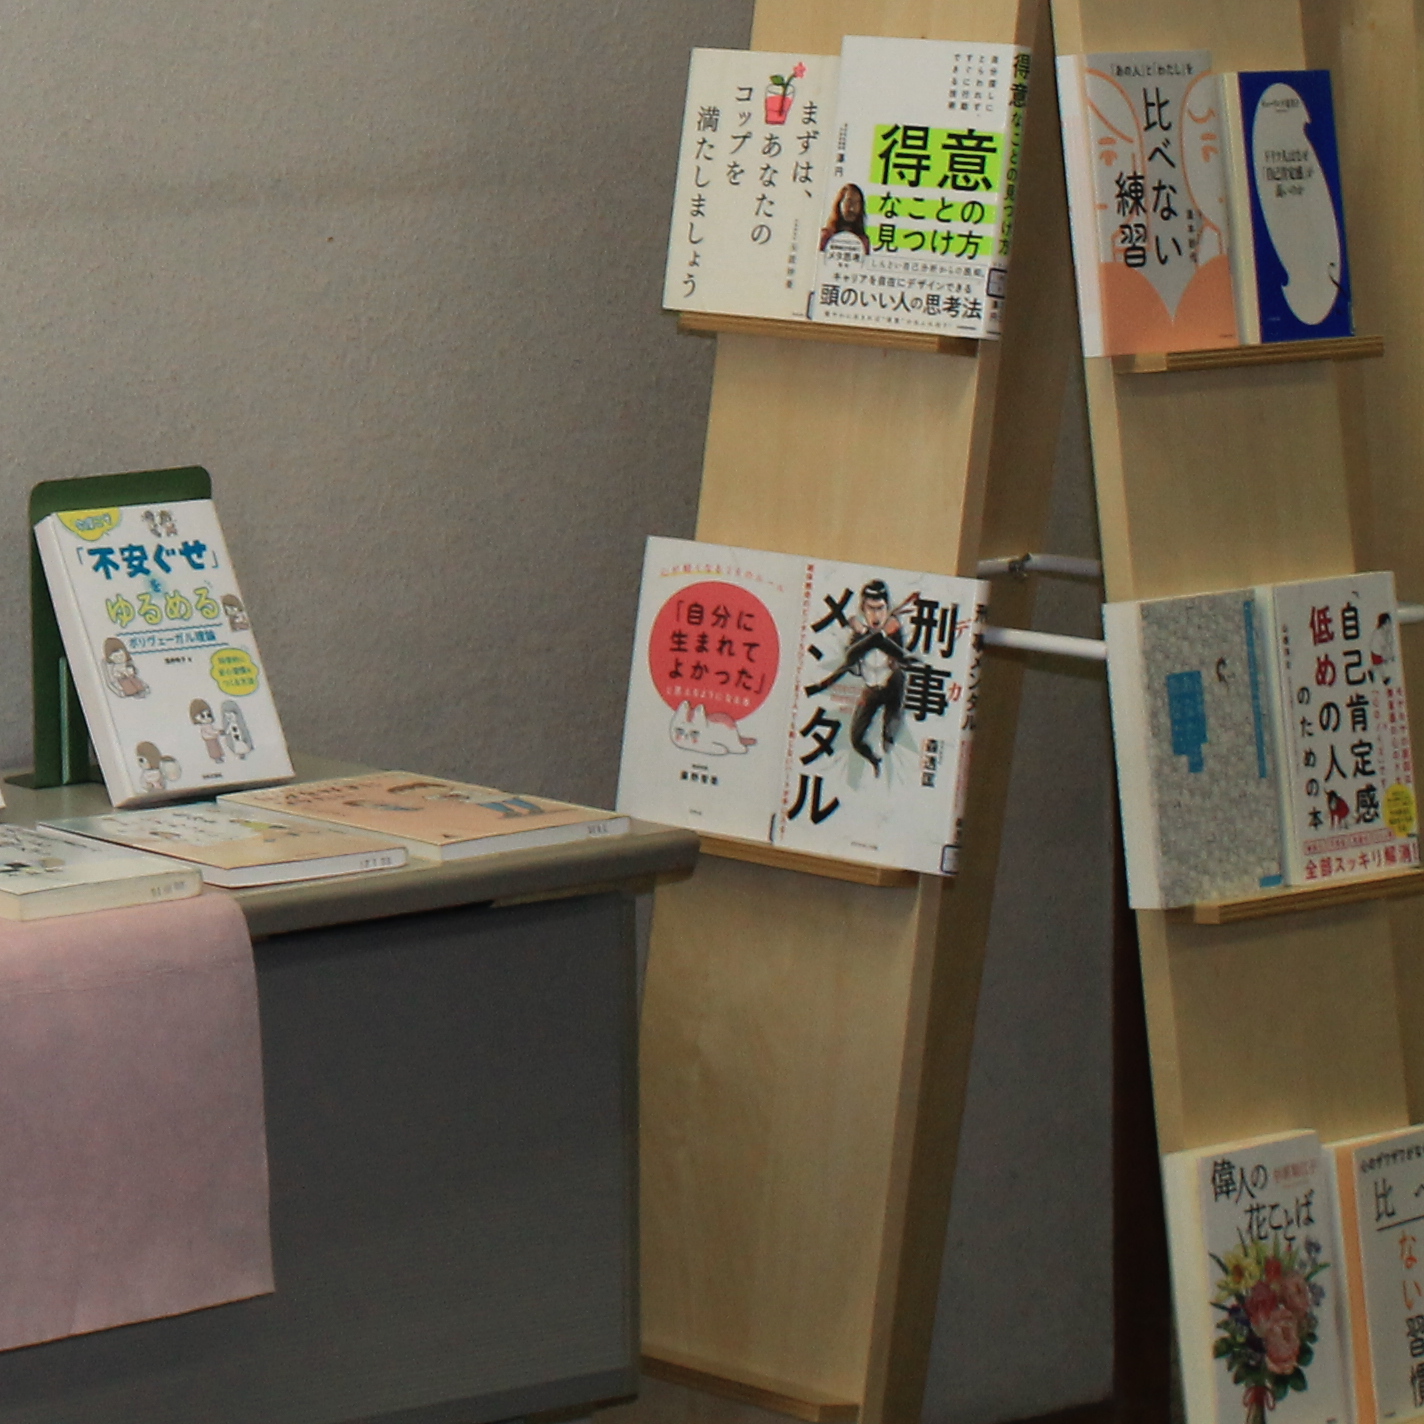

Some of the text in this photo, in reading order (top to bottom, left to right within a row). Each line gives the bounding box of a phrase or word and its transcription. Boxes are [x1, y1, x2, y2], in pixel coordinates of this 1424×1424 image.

[726, 85, 753, 186] コップを
[791, 100, 820, 199] まずは、
[877, 124, 997, 192] 得意
[1141, 86, 1183, 265] 比べない
[682, 105, 720, 298] 満たしましょう
[751, 132, 782, 245] あなたの
[879, 191, 985, 226] なことの
[1114, 170, 1148, 268] 練習
[872, 224, 983, 260] 見つけ方
[819, 282, 983, 320] 頭のいい人の思考法
[76, 539, 219, 580] 「不安ぐせ」
[105, 585, 221, 629] ゆるめる
[669, 630, 761, 664] 生まれて
[676, 599, 755, 632] 「自分に
[668, 660, 767, 696] よかった」
[903, 596, 959, 723] 刑事
[1308, 605, 1348, 783] 低めの人
[786, 587, 854, 825] メンタル
[1297, 686, 1324, 830] のための本
[1210, 1156, 1271, 1204] 偉人の
